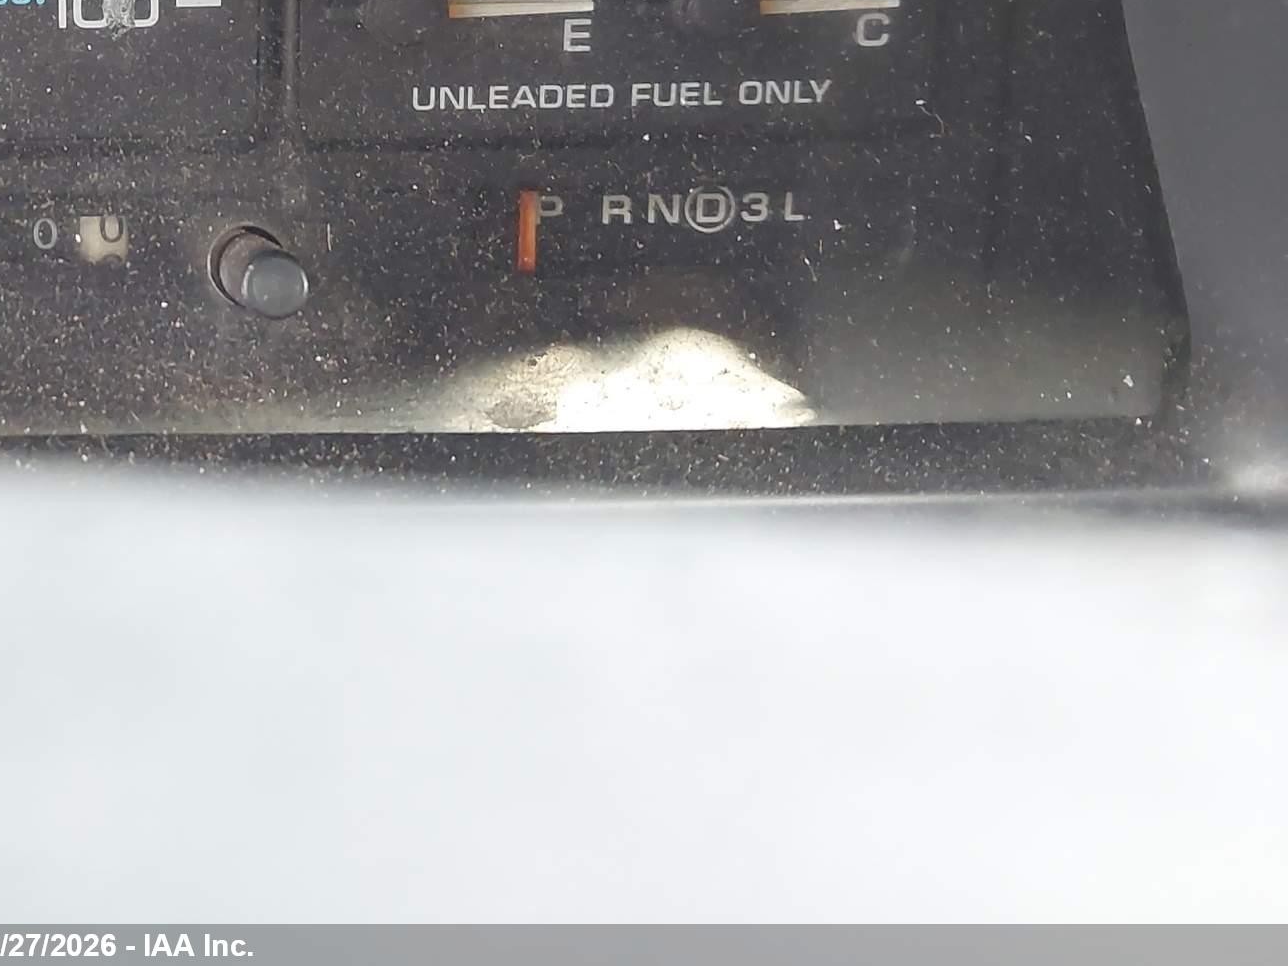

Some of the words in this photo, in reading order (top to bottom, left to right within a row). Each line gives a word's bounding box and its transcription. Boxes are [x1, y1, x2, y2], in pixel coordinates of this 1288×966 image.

[564, 19, 592, 52] E
[856, 13, 891, 47] C
[412, 83, 614, 111] UNLEADED
[631, 82, 722, 108] FUEL
[738, 80, 832, 105] ONLY
[535, 194, 564, 224] P
[602, 194, 632, 224] R
[647, 192, 682, 224] N
[695, 193, 722, 223] D
[740, 192, 769, 222] 3
[784, 191, 805, 221] L
